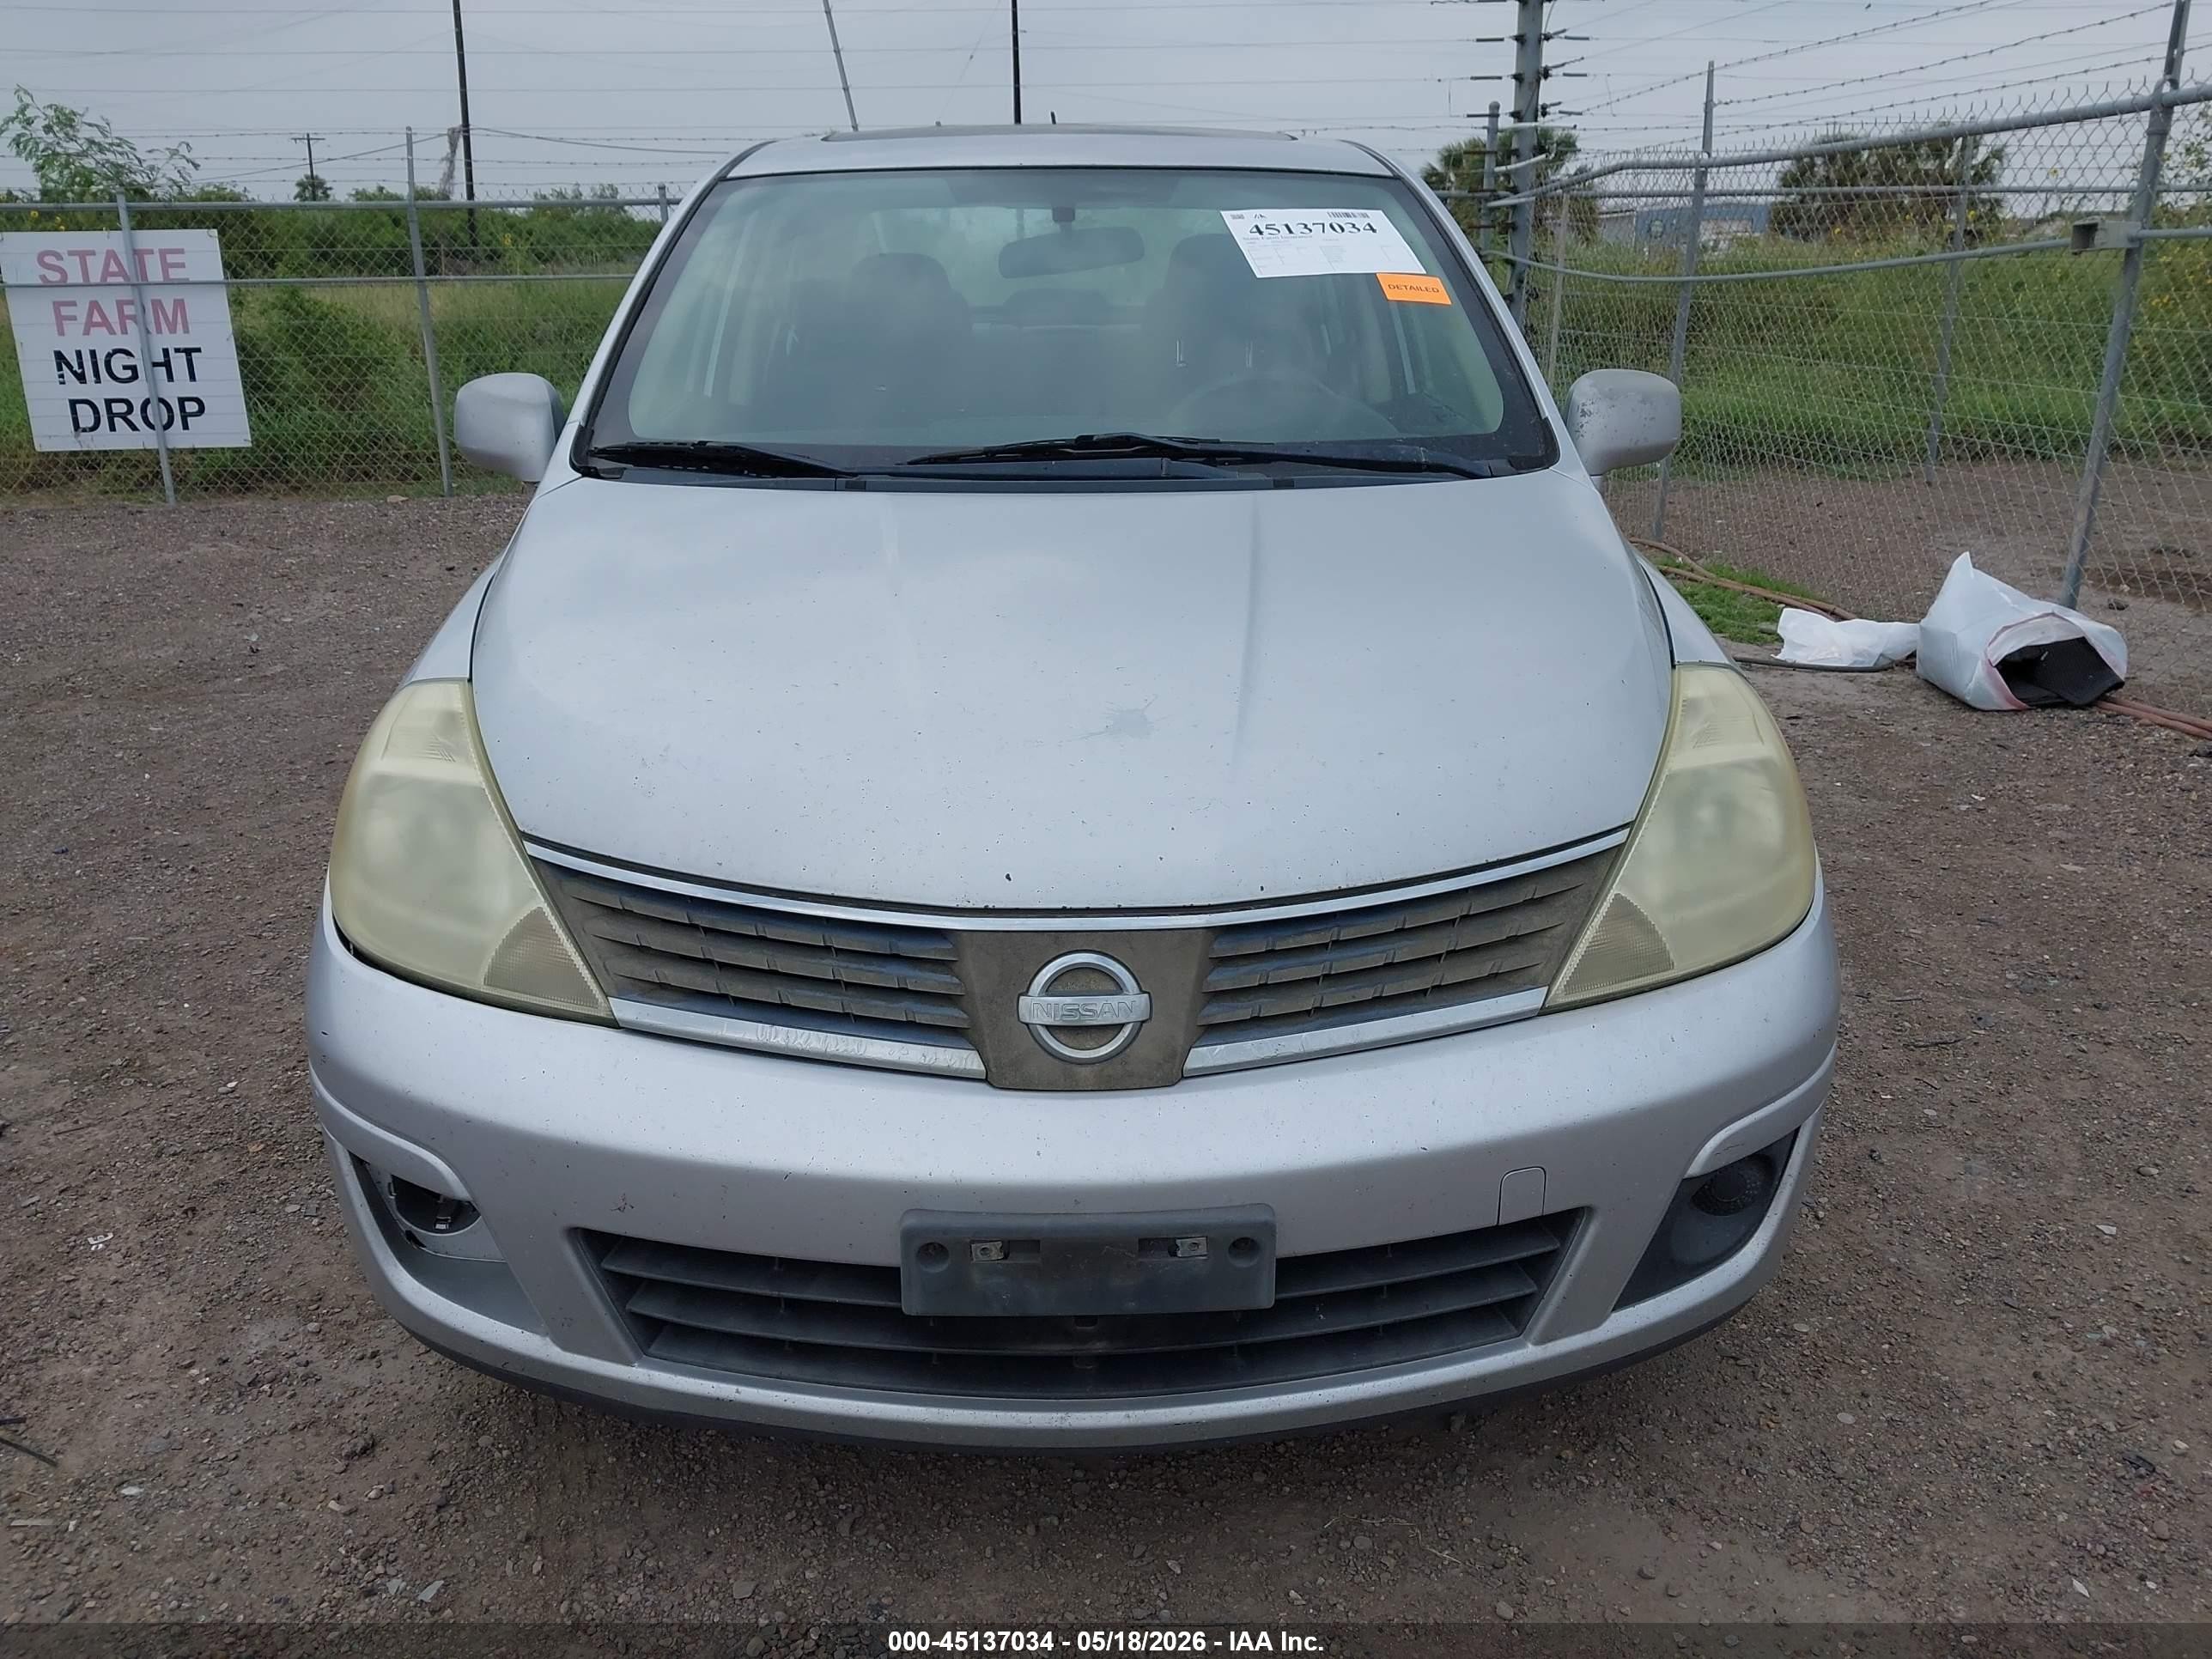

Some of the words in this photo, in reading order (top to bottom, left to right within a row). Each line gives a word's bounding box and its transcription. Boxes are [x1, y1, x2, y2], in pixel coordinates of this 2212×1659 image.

[1249, 222, 1377, 236] 45137034
[36, 248, 190, 284] STATE
[1387, 283, 1440, 294] DETAILED
[52, 298, 191, 337] FARM
[53, 347, 202, 385] NIGHT
[68, 396, 206, 433] DROP
[1031, 1000, 1135, 1021] NISSAN
